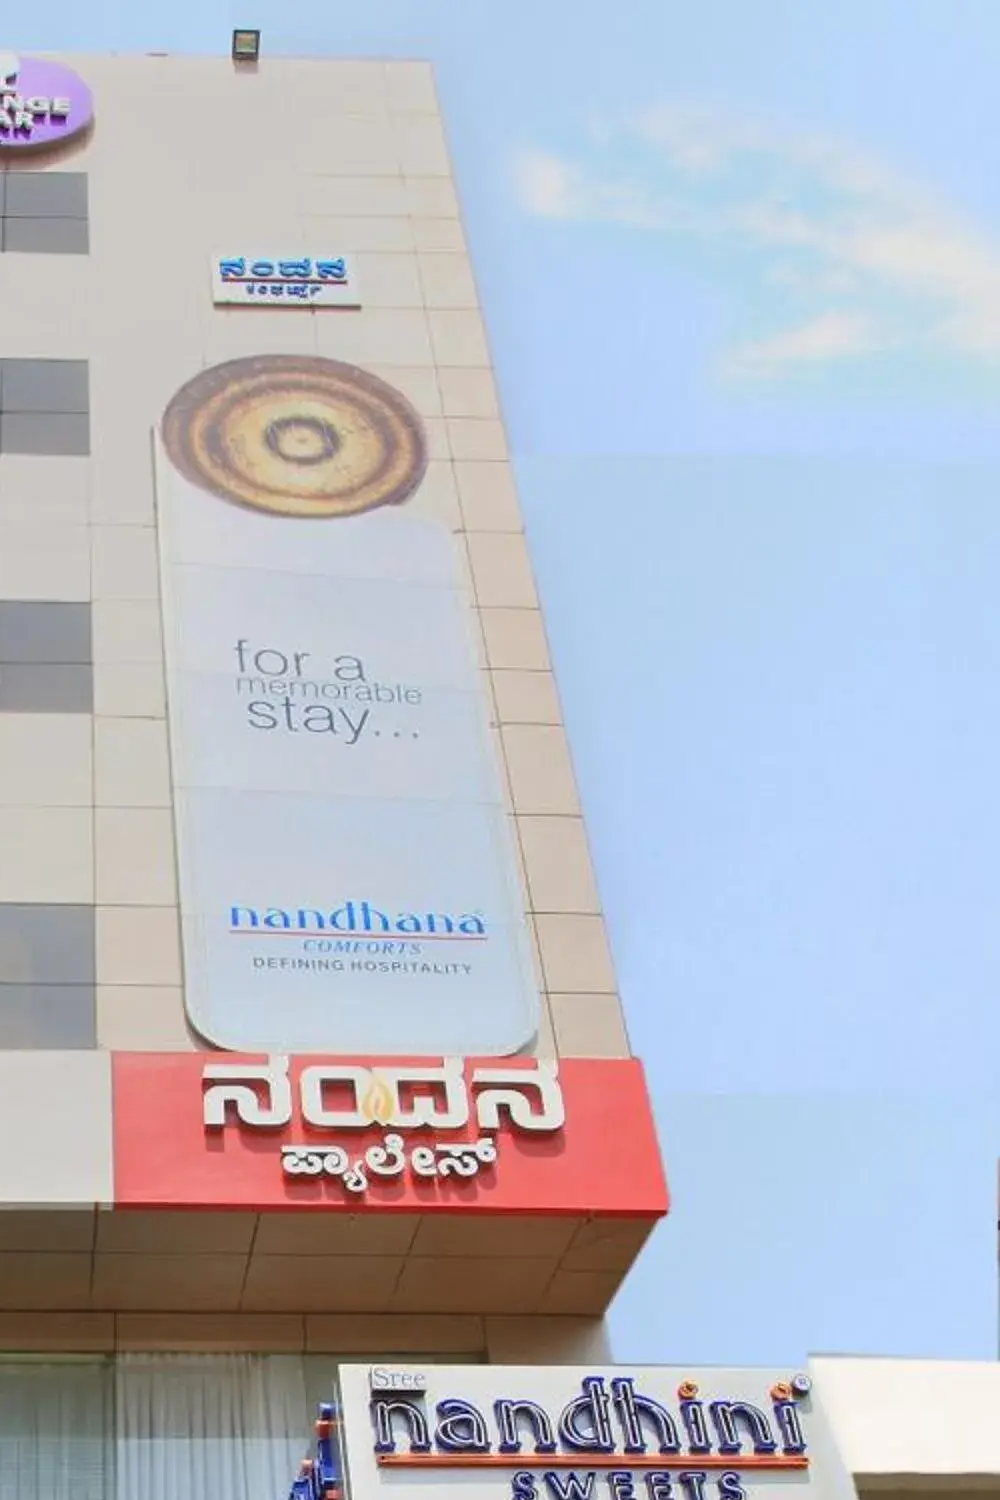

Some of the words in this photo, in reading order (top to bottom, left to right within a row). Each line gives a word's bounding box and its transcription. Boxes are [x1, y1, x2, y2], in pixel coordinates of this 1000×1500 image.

[234, 639, 310, 677] for
[333, 655, 366, 682] a
[236, 677, 422, 704] memorable
[231, 901, 485, 934] nandhana
[303, 939, 422, 956] COMFORTS
[253, 957, 345, 971] DEFINING
[351, 959, 472, 974] HOSPITALITY
[374, 1367, 425, 1388] Sree
[370, 1376, 807, 1454] nandhini
